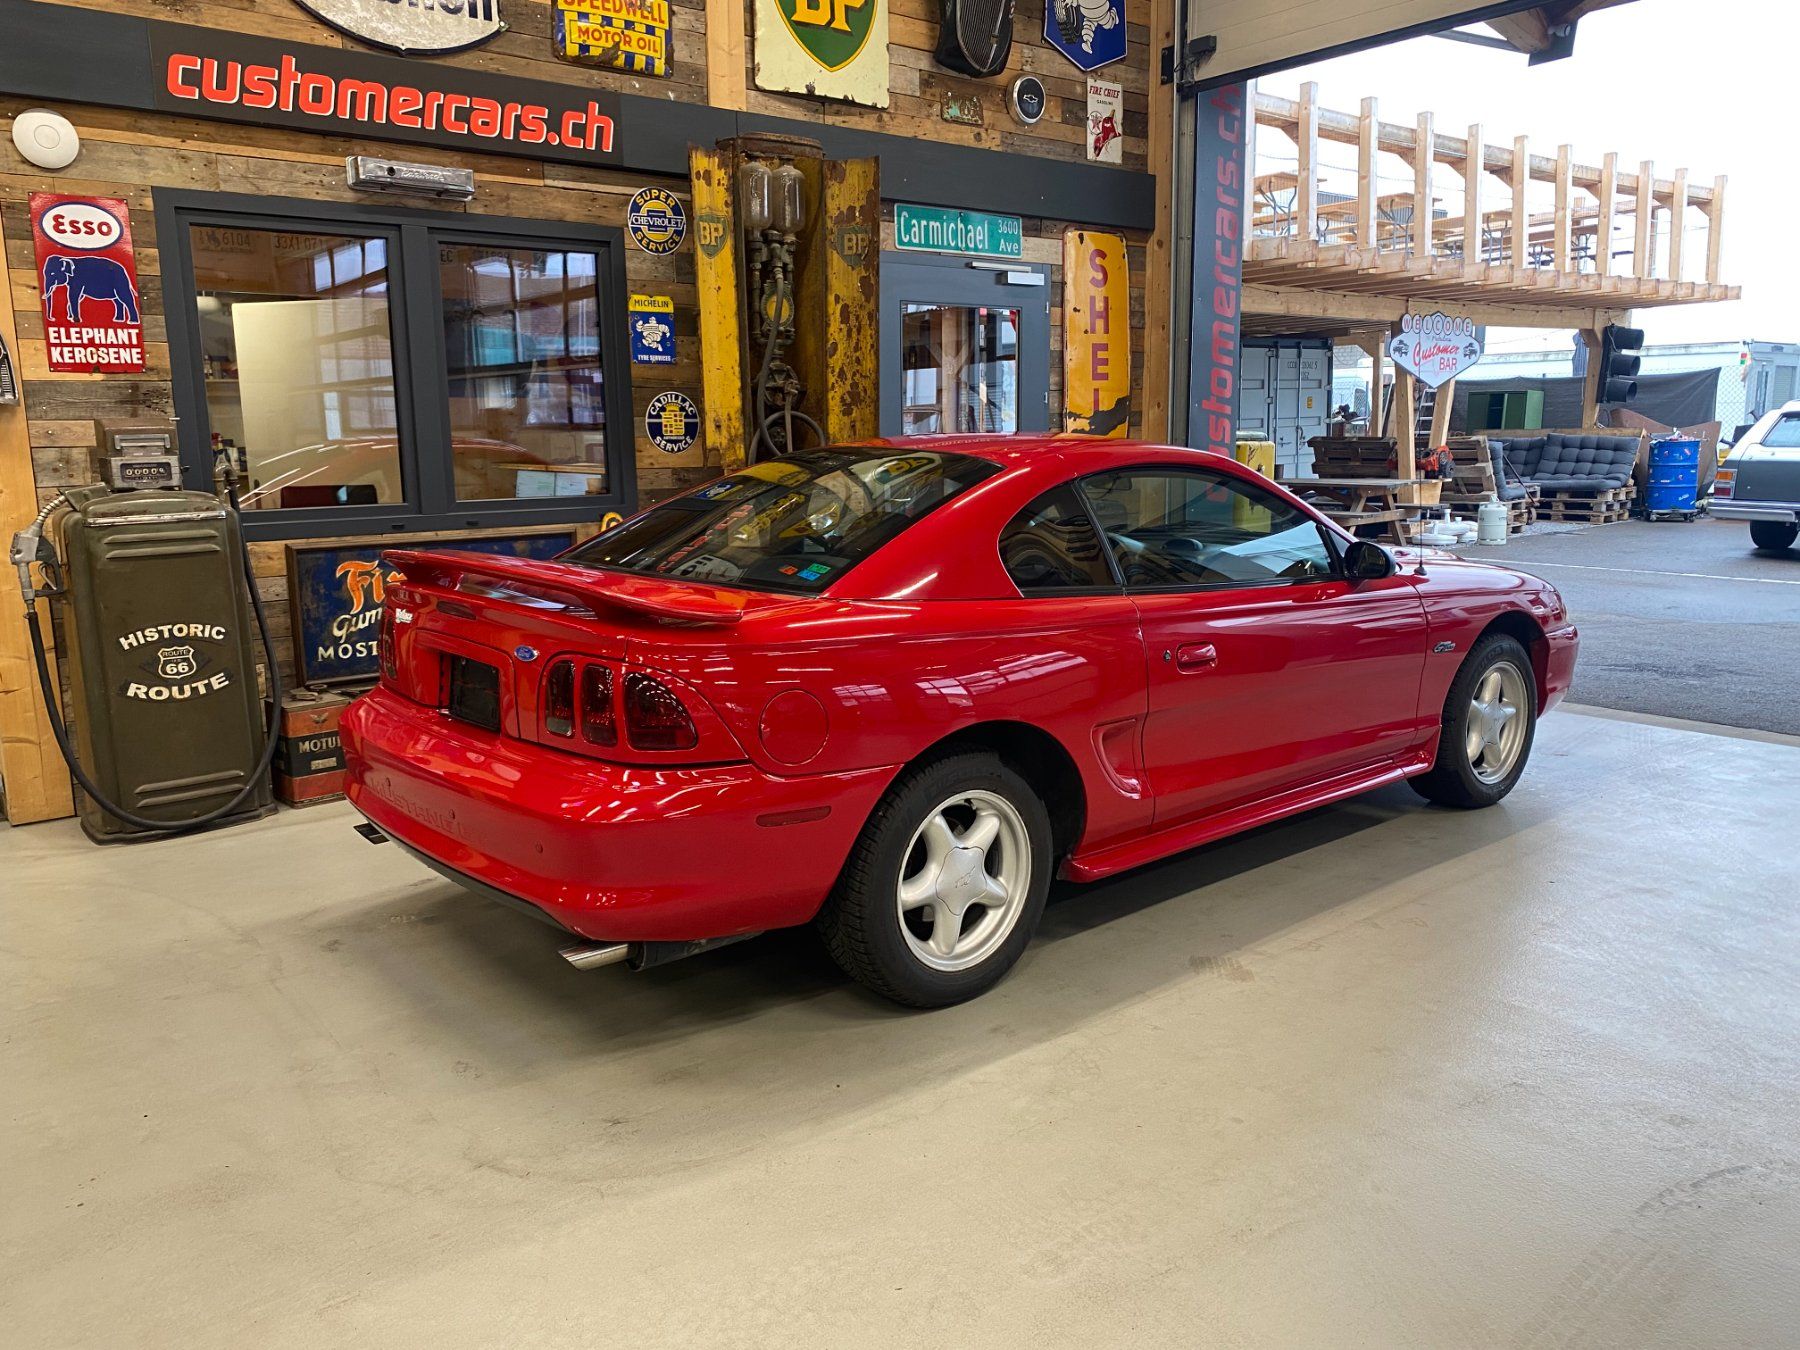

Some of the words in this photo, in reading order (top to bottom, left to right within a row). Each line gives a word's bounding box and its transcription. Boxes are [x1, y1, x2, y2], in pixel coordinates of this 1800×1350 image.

[577, 26, 632, 47] MOTOR
[637, 37, 658, 53] OIL
[1089, 86, 1103, 96] FIRE
[1104, 88, 1120, 98] CHIEF
[166, 53, 615, 153] customercars.ch
[636, 189, 676, 208] SUPER
[632, 215, 682, 227] CHEVROLET
[900, 211, 989, 250] Carmichael
[998, 219, 1018, 235] 3600
[635, 231, 680, 252] SERVICE
[699, 221, 724, 246] BP
[844, 233, 870, 256] BP
[999, 239, 1019, 253] Ave
[634, 299, 669, 308] MICHELIN
[48, 326, 139, 345] ELEPHANT
[1403, 316, 1471, 336] WELCOME
[50, 346, 143, 364] KEROSENE
[1413, 340, 1459, 367] Customer
[1439, 357, 1457, 371] BAR
[650, 394, 695, 415] CADILLAC
[654, 436, 693, 452] SERVICE
[119, 623, 226, 651] HISTORIC
[162, 649, 189, 657] ROUTE
[165, 662, 189, 675] 66
[127, 672, 230, 701] ROUTE
